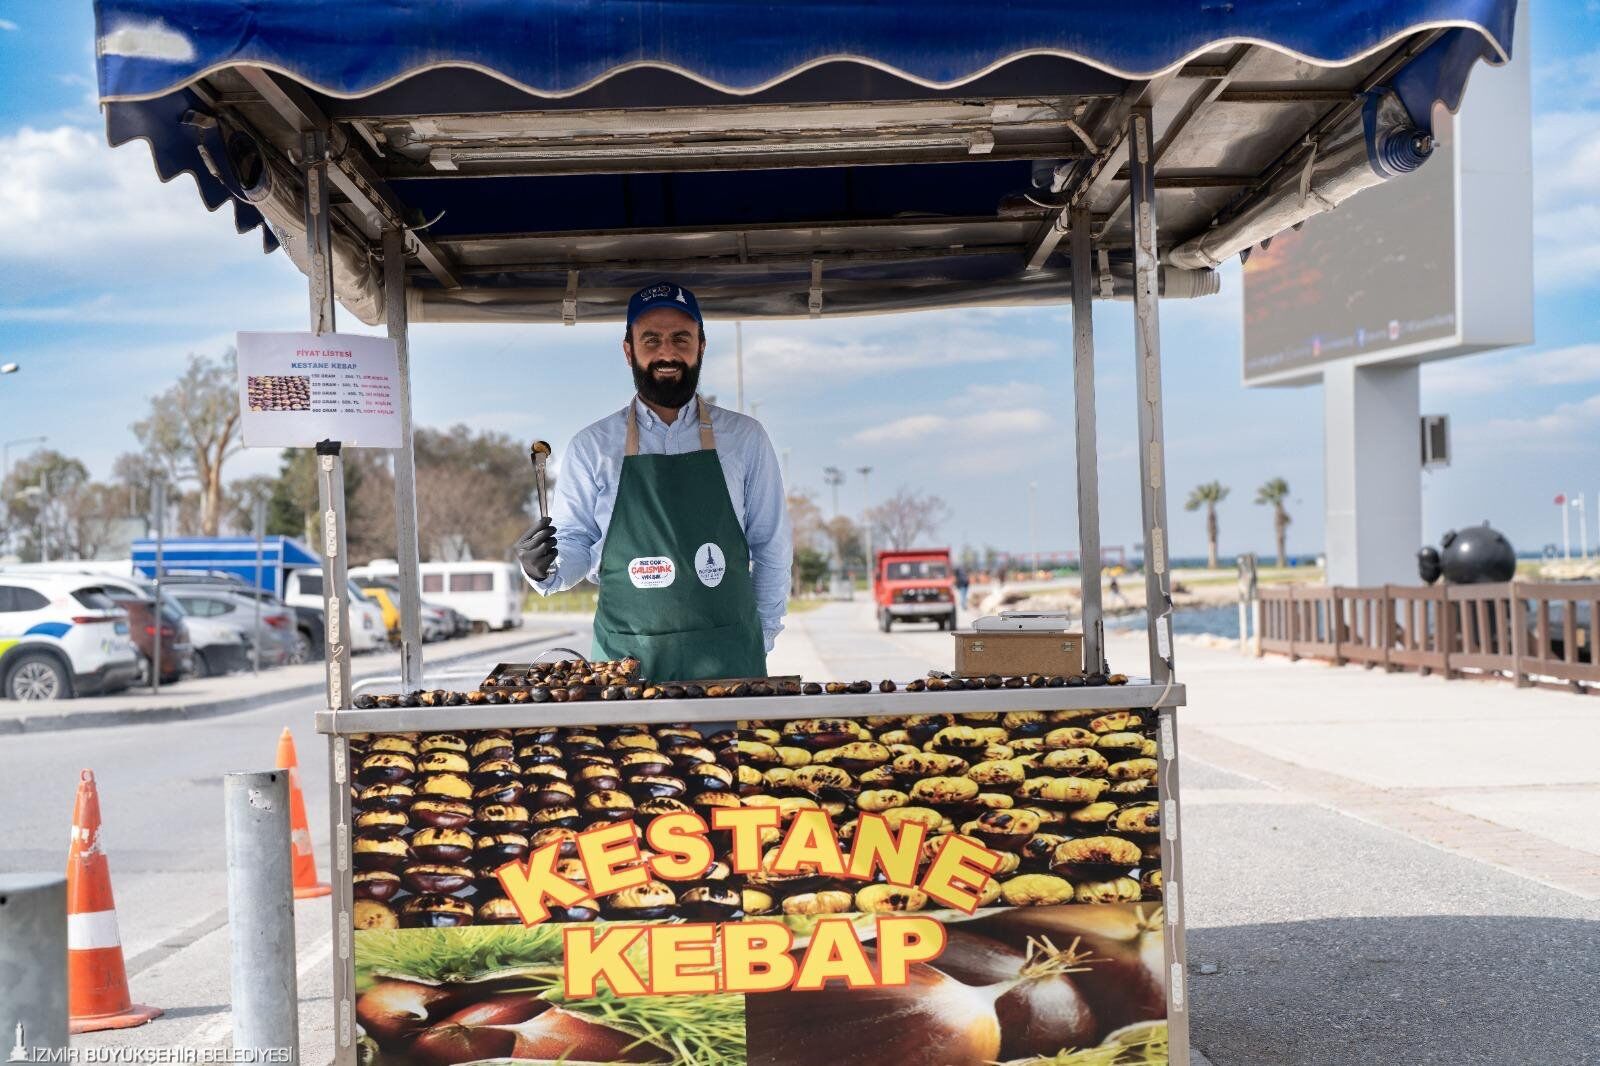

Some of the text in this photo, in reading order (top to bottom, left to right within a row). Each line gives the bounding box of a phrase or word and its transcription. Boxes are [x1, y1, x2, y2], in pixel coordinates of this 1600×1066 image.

[296, 348, 352, 358] FİYAT LİSTESİ
[495, 806, 1003, 927] KESTANE
[563, 915, 947, 998] KEBAP
